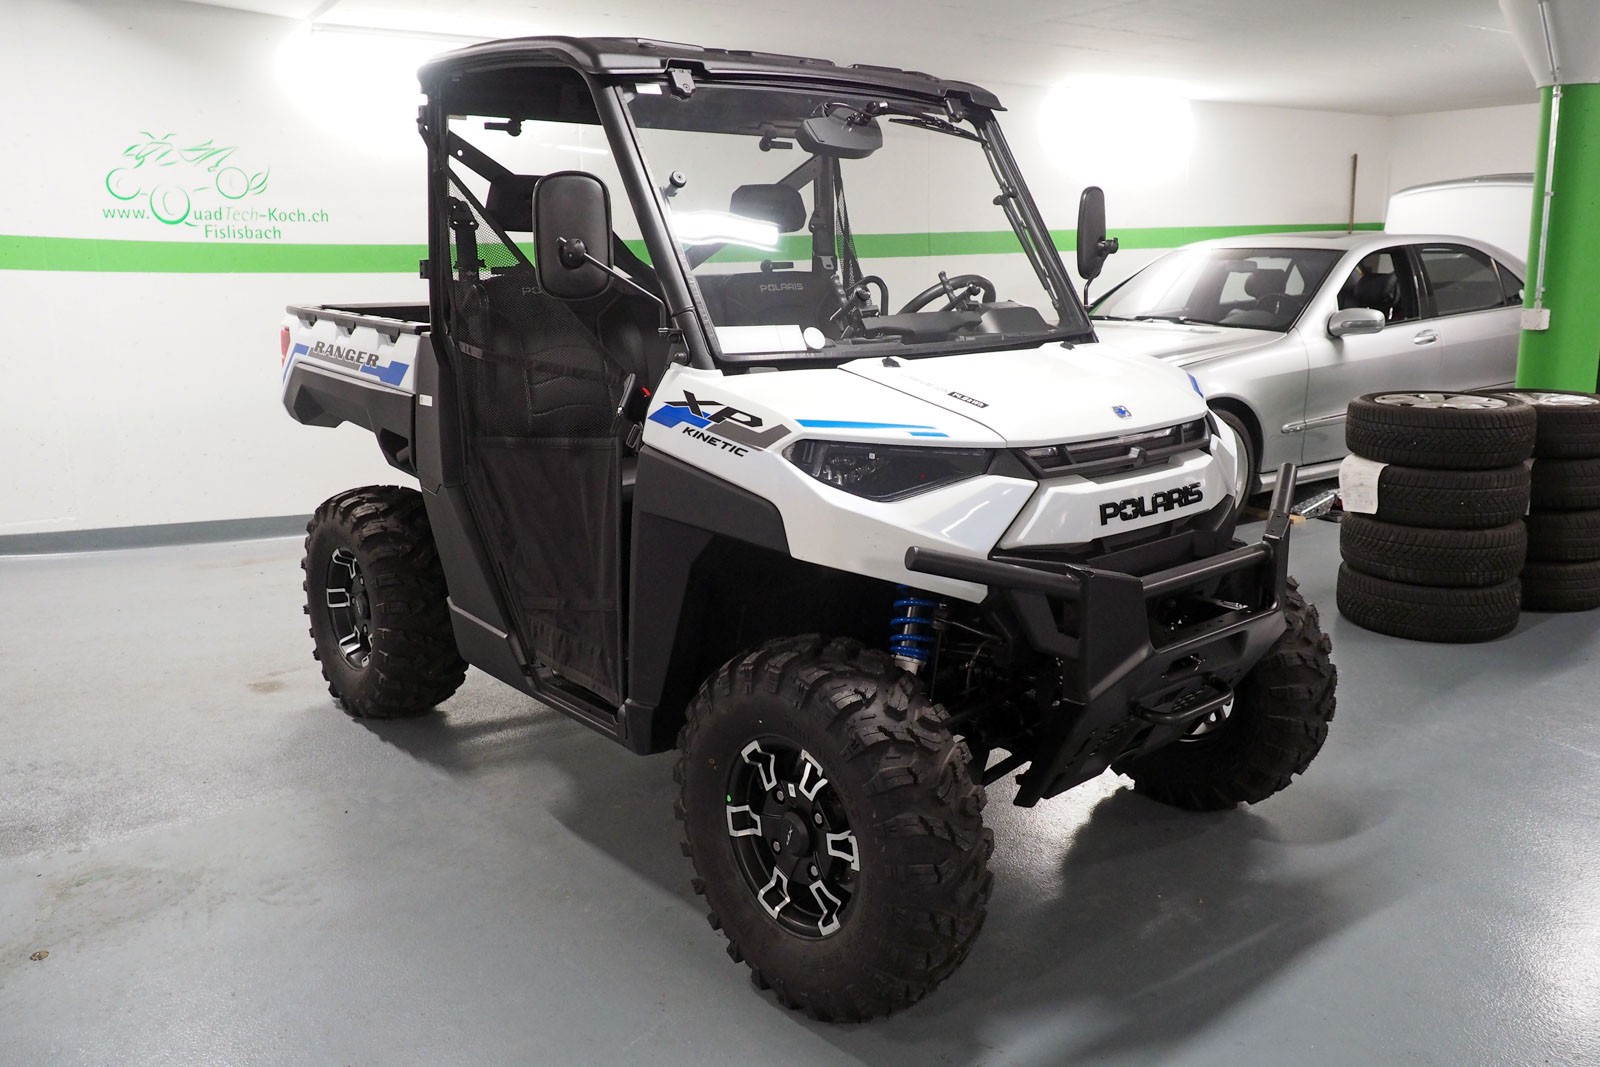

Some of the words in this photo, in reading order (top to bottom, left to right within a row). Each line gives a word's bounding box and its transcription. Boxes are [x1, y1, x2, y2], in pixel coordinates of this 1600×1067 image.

[204, 224, 282, 240] Fislisbach
[759, 282, 804, 293] POLARIS
[313, 340, 381, 369] RANGER
[664, 389, 764, 428] XP
[682, 426, 749, 458] KINETIC
[1099, 481, 1204, 526] POLARIS
